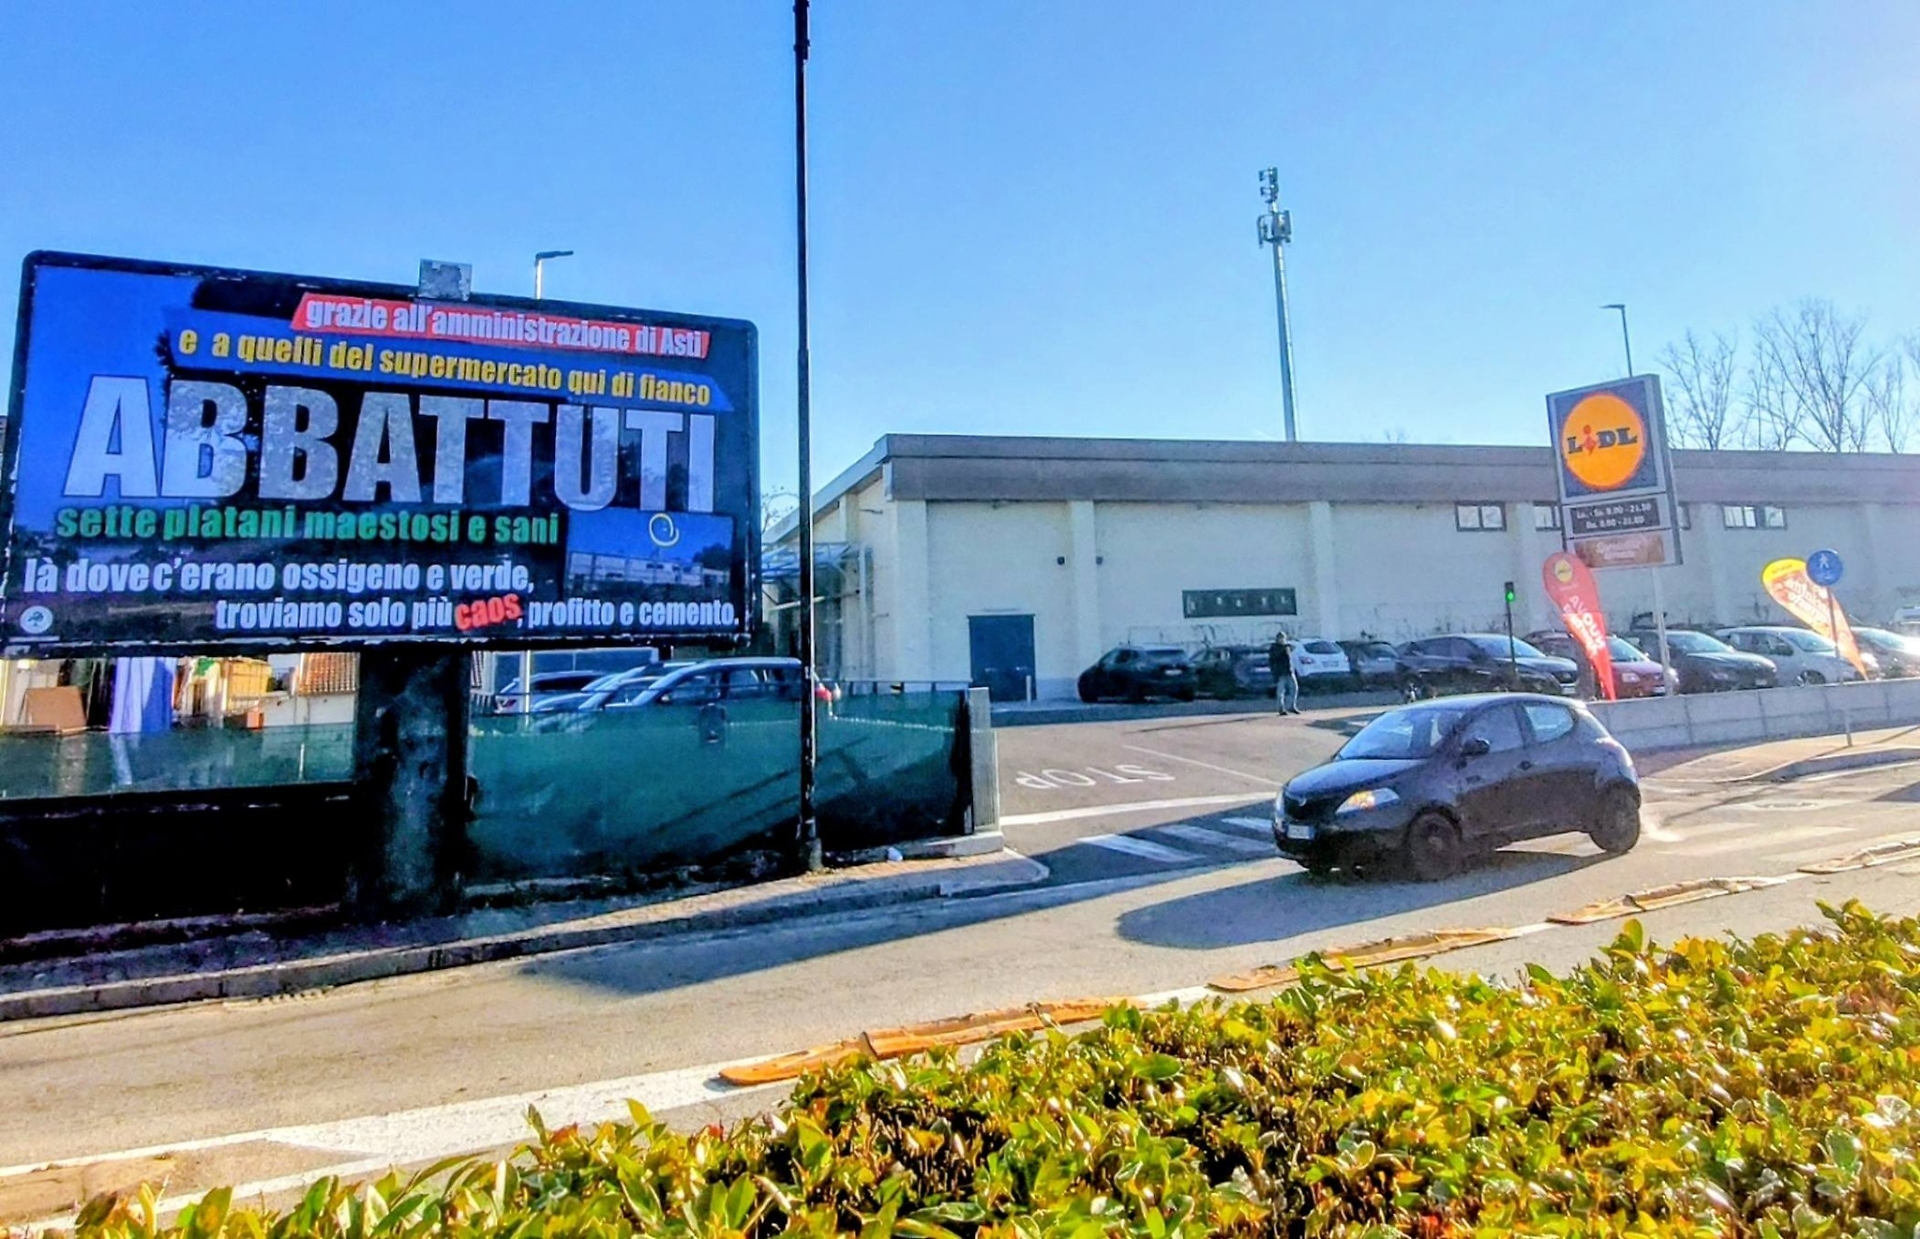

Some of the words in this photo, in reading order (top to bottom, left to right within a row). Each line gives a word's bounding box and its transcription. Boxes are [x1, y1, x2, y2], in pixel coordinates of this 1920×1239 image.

[306, 299, 388, 330] grazie
[392, 304, 630, 348] all'amministrazione
[635, 325, 658, 354] di
[660, 329, 703, 358] Asti
[178, 329, 199, 354] e
[211, 333, 230, 357] a
[237, 333, 323, 366] quelli
[329, 341, 374, 371] del
[379, 350, 562, 388] supermercato
[567, 369, 606, 396] qui
[611, 372, 634, 398] di
[640, 374, 710, 406] fianco
[63, 375, 715, 512] ABBATTUTI
[57, 506, 156, 538] sette
[164, 505, 297, 540] platani
[304, 507, 459, 541] maestosi
[468, 515, 487, 544] e
[494, 514, 558, 543] sani
[24, 558, 58, 592] là
[66, 560, 151, 592] dove
[153, 558, 276, 592] c'erano
[282, 558, 419, 593] ossigeno
[426, 563, 444, 591] e
[450, 560, 534, 593] verde,
[216, 598, 342, 629] troviamo
[347, 597, 406, 628] solo
[411, 597, 452, 631] più
[528, 598, 614, 629] profitto
[619, 600, 634, 626] e
[638, 600, 739, 626] cemento.
[1015, 764, 1175, 789] STOP
